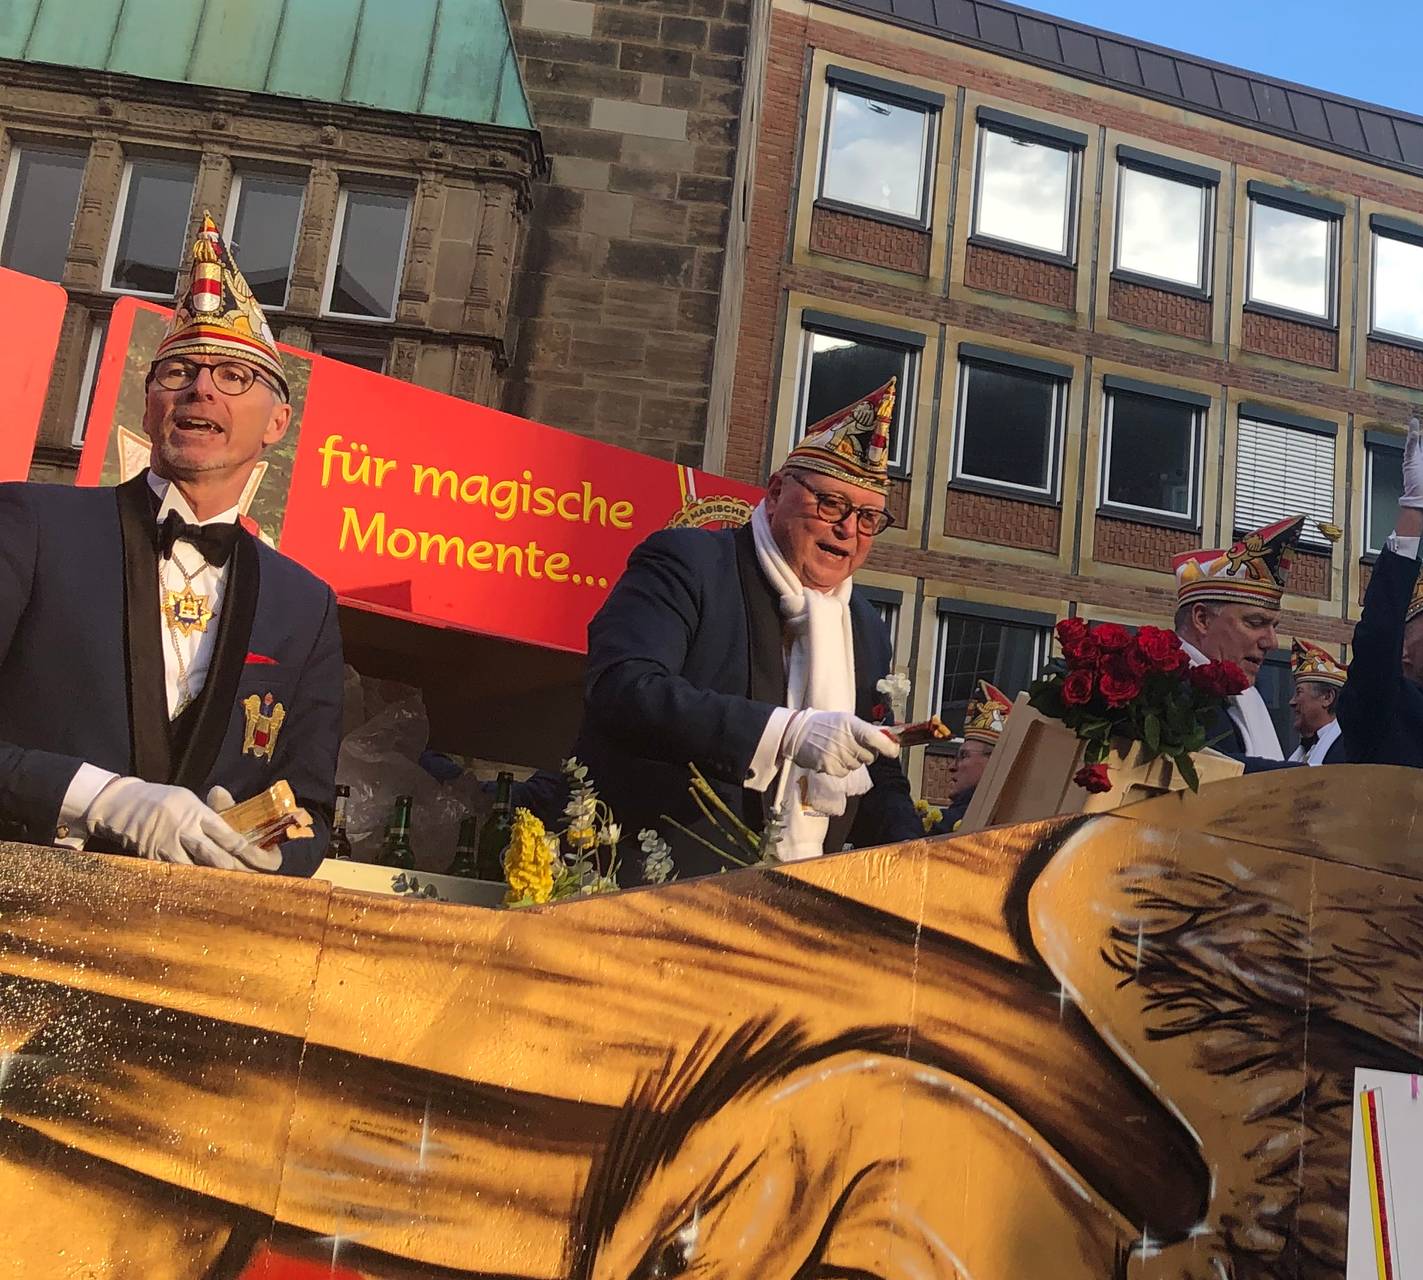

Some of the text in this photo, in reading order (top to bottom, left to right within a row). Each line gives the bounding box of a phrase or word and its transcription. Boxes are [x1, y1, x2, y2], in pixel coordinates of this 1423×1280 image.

[318, 434, 634, 529] für magische
[690, 504, 746, 519] MAGISCHE
[338, 507, 609, 588] Momente...
